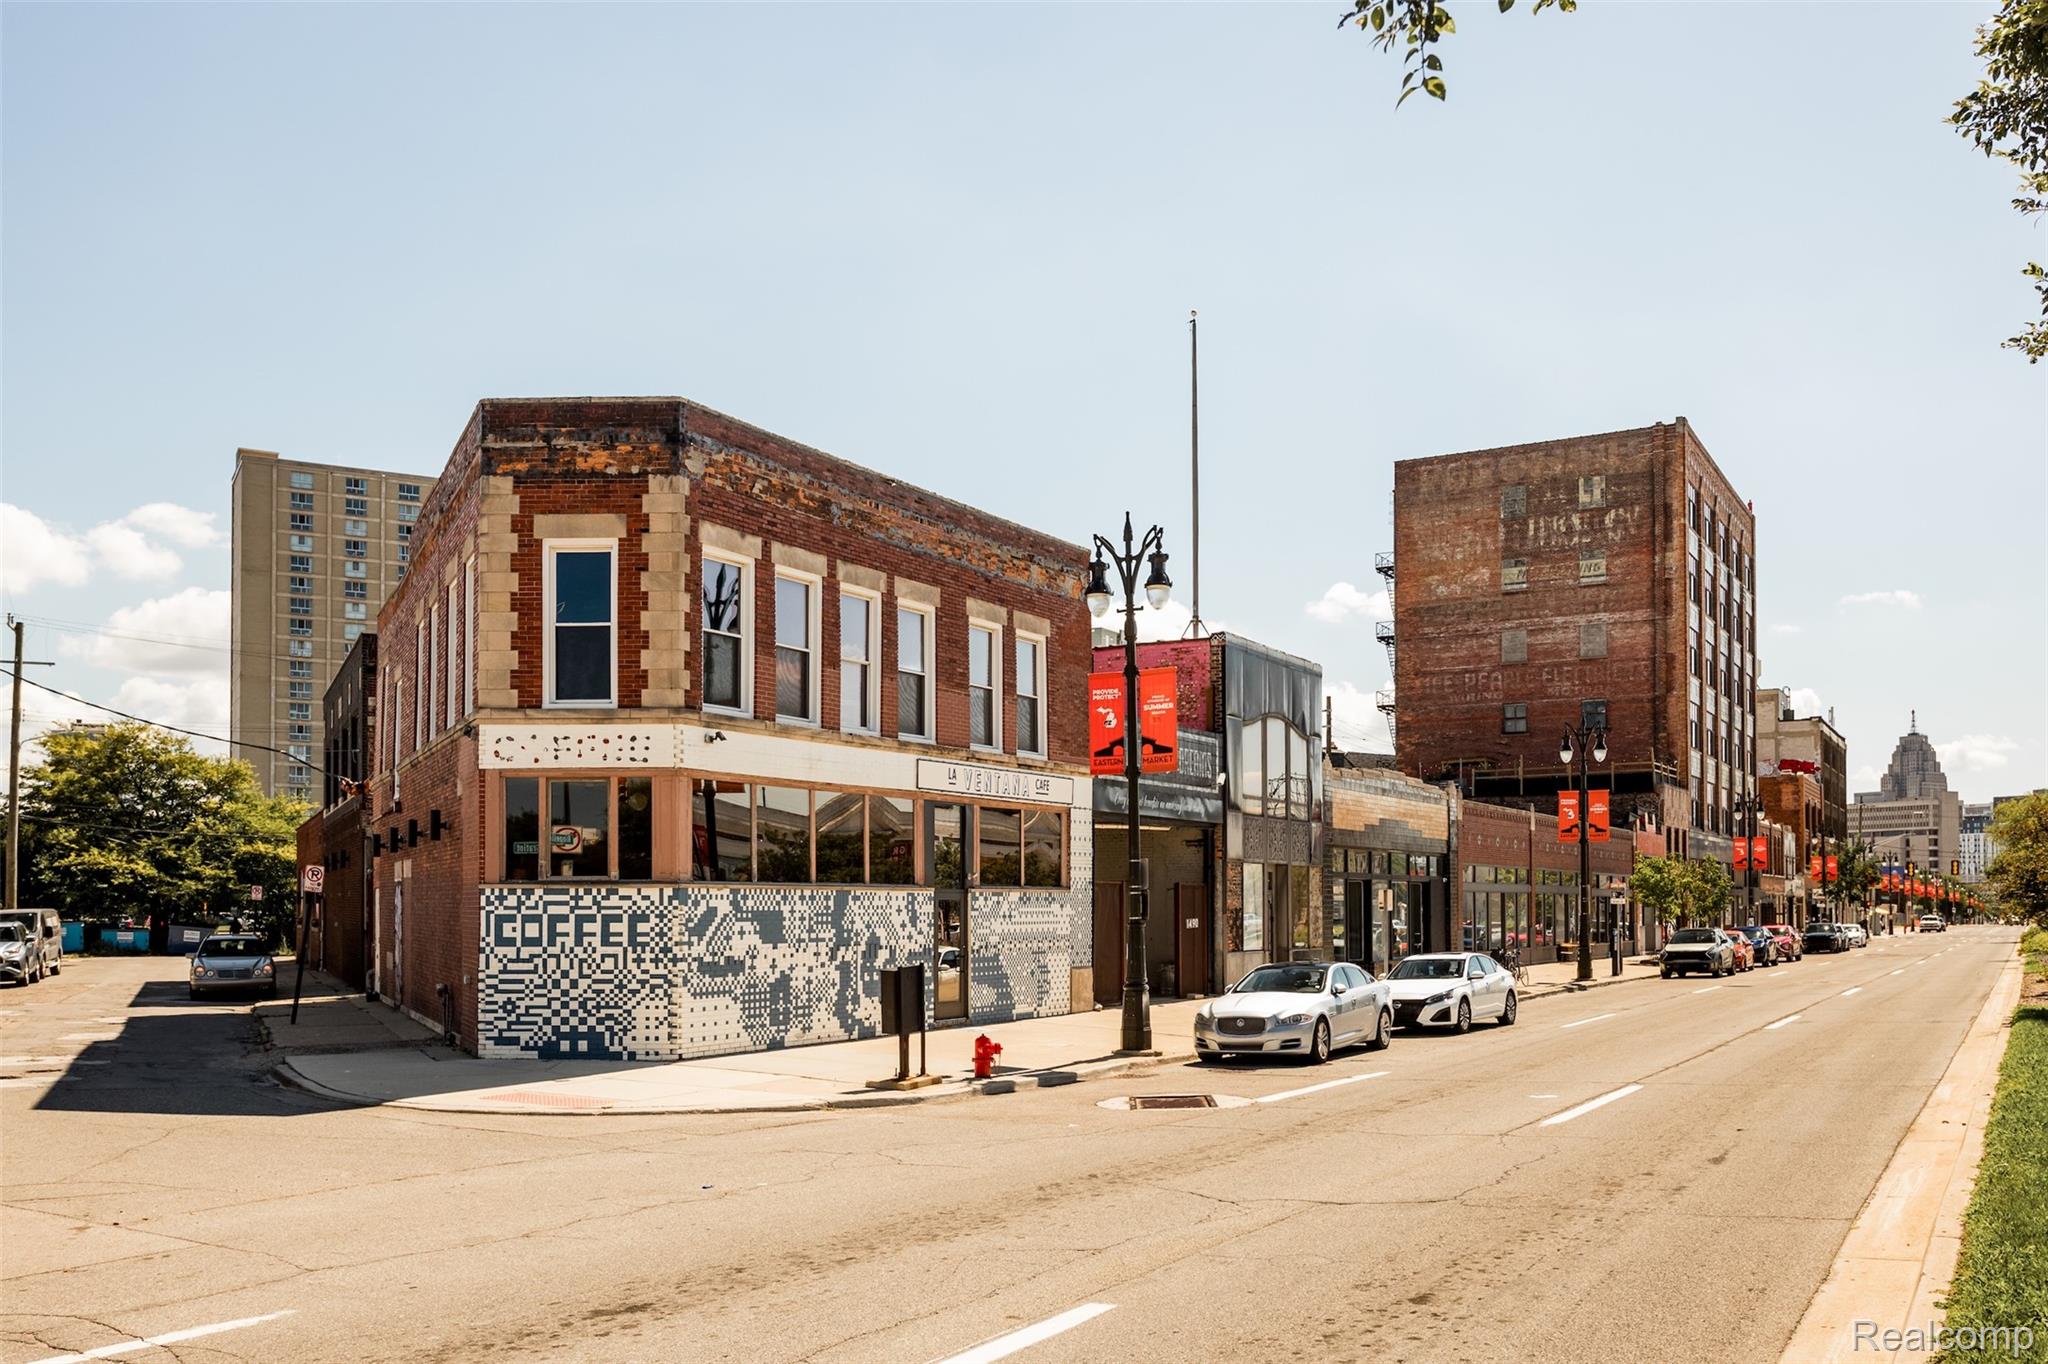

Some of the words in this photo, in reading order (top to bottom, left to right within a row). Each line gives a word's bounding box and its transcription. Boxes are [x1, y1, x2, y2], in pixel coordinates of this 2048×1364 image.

[1143, 702, 1174, 711] SUMMER
[1094, 758, 1124, 767] EASTERN
[1143, 755, 1174, 765] MARKET
[948, 767, 957, 780] LA
[963, 768, 1030, 797] VENTANA
[1035, 778, 1050, 792] CAFE
[494, 913, 650, 948] COFFEE
